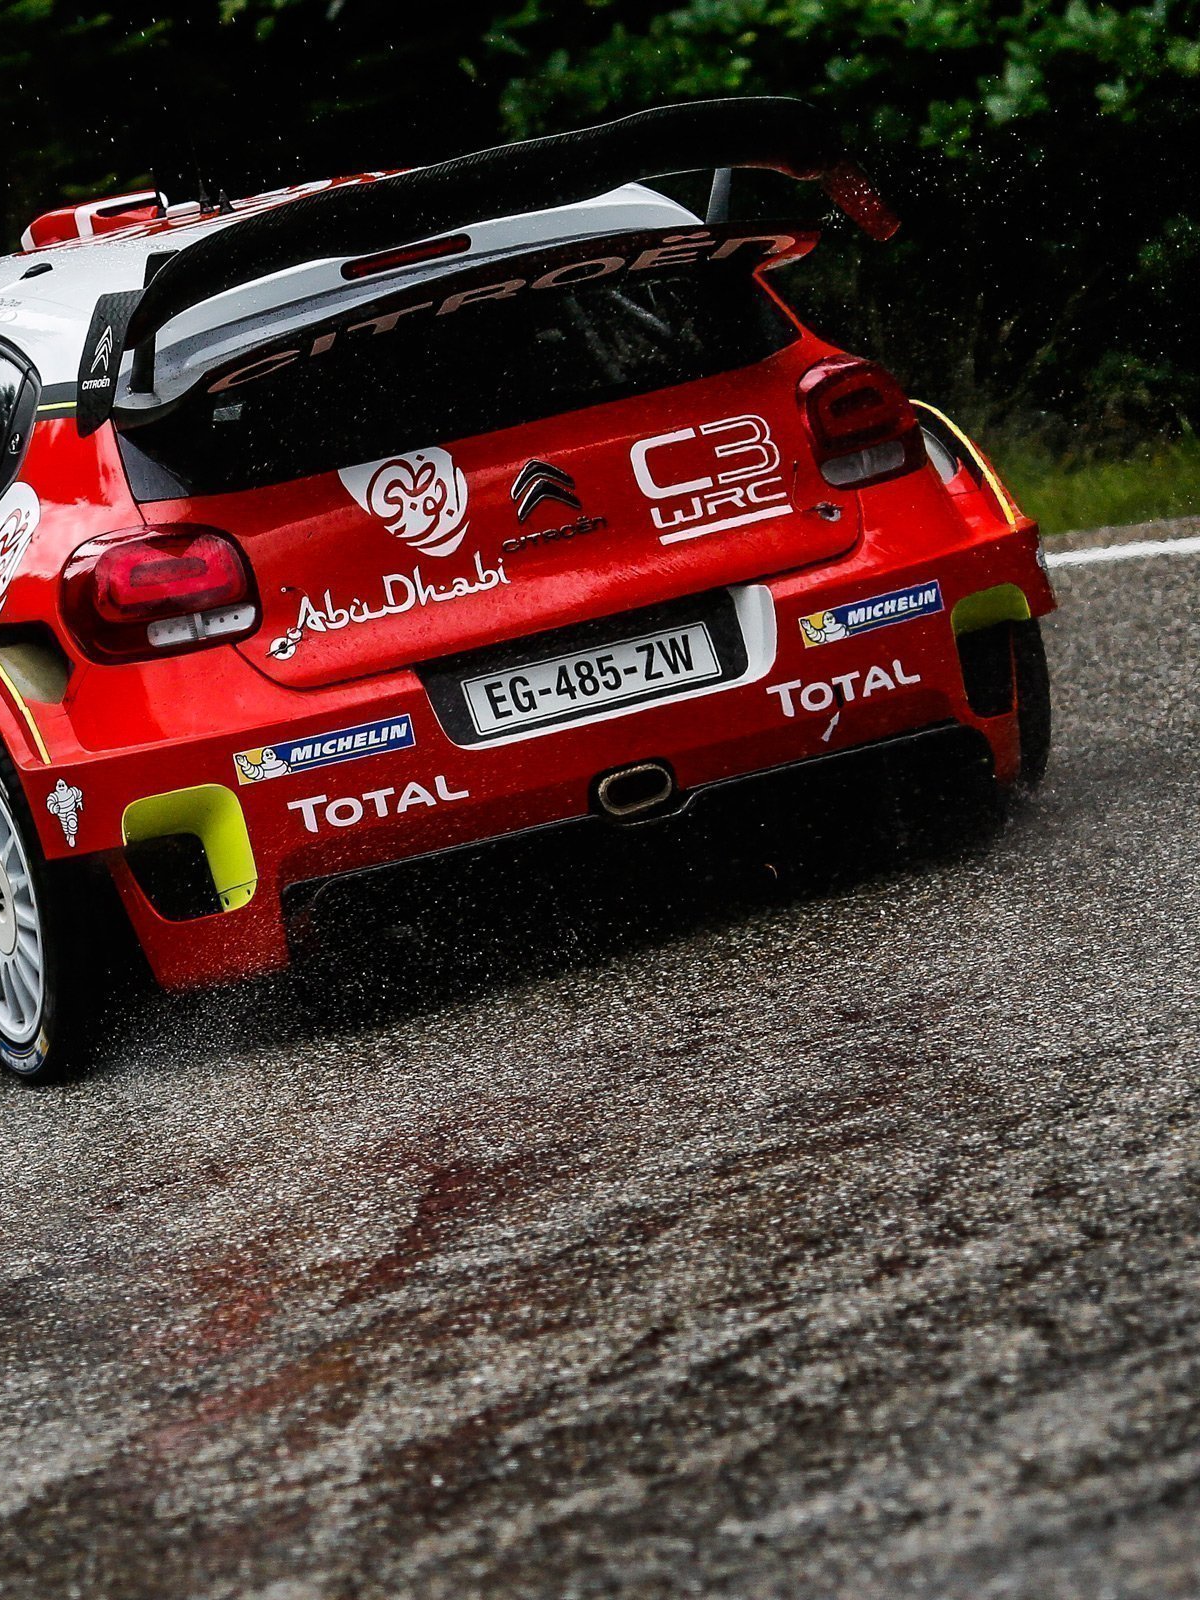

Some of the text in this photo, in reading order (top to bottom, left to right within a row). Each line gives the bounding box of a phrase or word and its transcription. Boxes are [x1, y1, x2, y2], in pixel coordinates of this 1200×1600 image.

[630, 414, 780, 499] C3
[650, 476, 788, 529] WRC
[847, 587, 937, 626] MICHELIN
[483, 634, 695, 720] EG-485-ZW
[765, 658, 921, 718] TOTAL
[289, 722, 408, 764] MICHELIN
[286, 774, 470, 833] TOTAL
